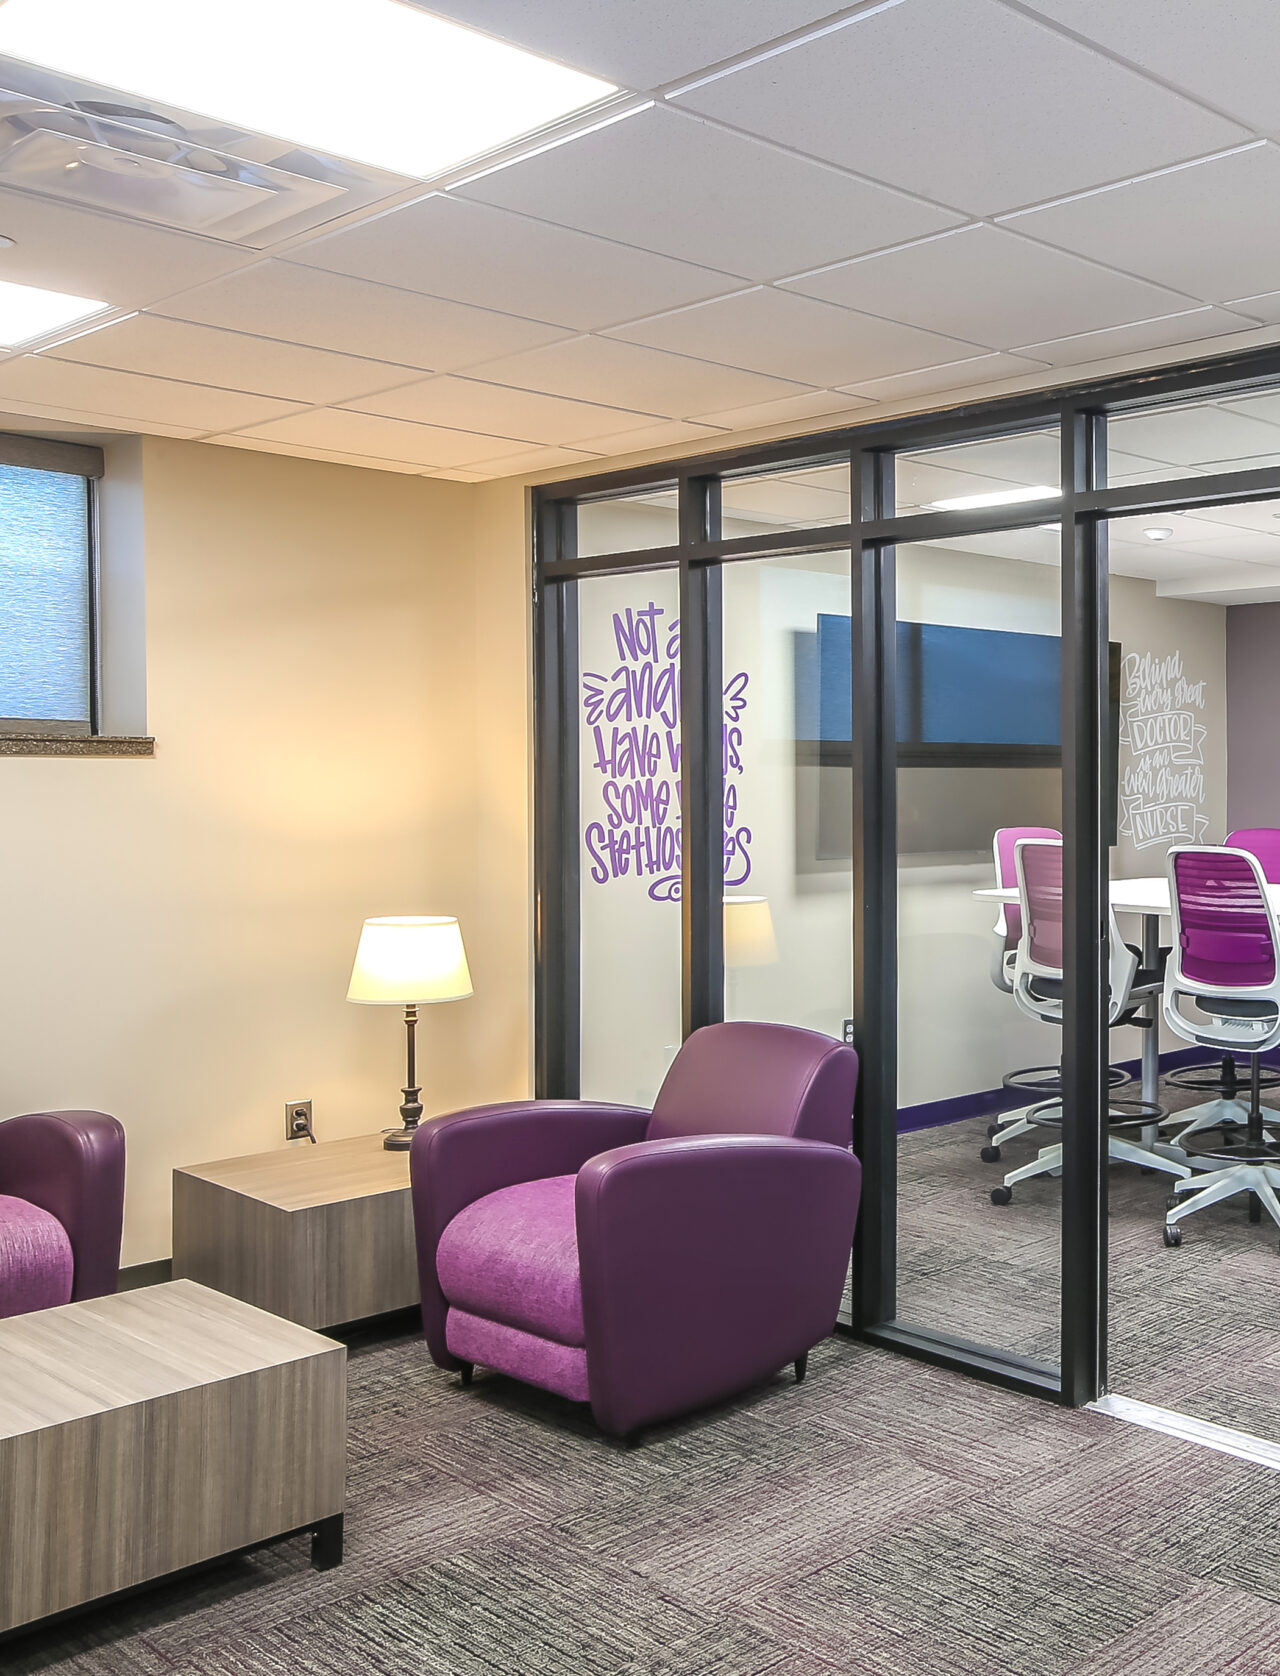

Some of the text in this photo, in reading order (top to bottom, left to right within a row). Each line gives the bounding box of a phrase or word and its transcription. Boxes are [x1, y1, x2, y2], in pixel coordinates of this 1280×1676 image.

[612, 602, 664, 663] Not
[605, 661, 681, 729] ang
[1122, 651, 1183, 697] Behind
[1137, 677, 1207, 712] every great
[593, 725, 661, 779] Have
[1133, 714, 1191, 750] DOCTOR
[1121, 766, 1206, 804] even greater
[1135, 806, 1190, 840] NURSE
